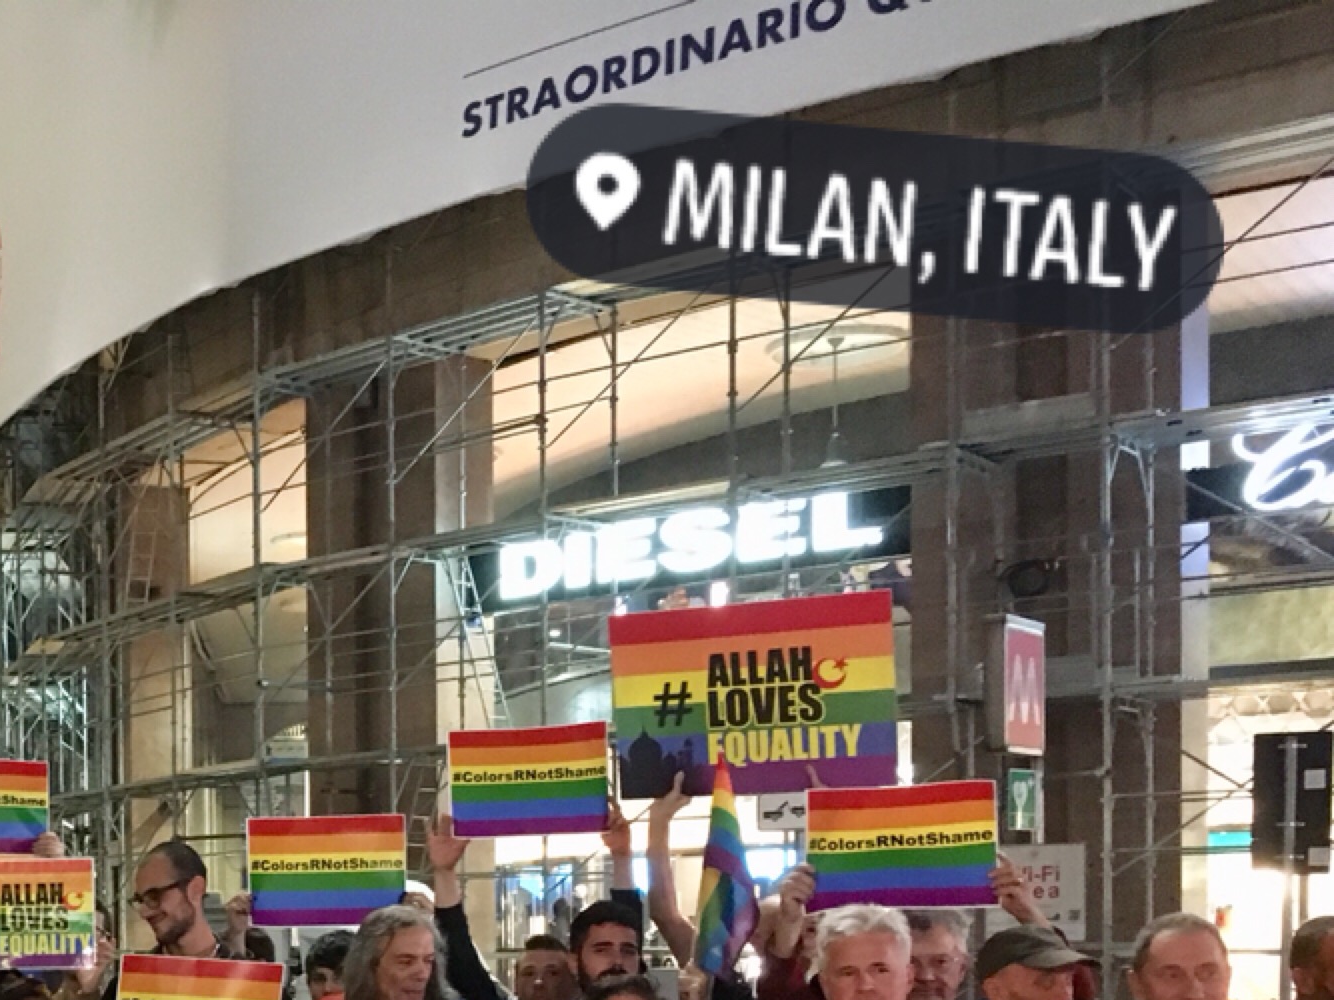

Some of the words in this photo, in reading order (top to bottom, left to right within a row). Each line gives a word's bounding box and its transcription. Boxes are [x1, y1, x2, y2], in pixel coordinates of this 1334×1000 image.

[461, 0, 846, 137] STRAORDINARIO
[498, 491, 884, 601] DIESEL
[707, 646, 813, 689] ALLAH
[707, 683, 824, 728] LOVES
[707, 723, 863, 766] EQUALITY
[453, 763, 607, 784] #ColorsRNotShame
[808, 827, 994, 852] #ColorsRNotShame
[251, 857, 403, 873] #ColorsRNotShame
[1022, 866, 1060, 882] i-Fi
[0, 882, 64, 906] ALLAH
[0, 905, 69, 931] LOVES
[0, 933, 92, 956] EQUALITY
